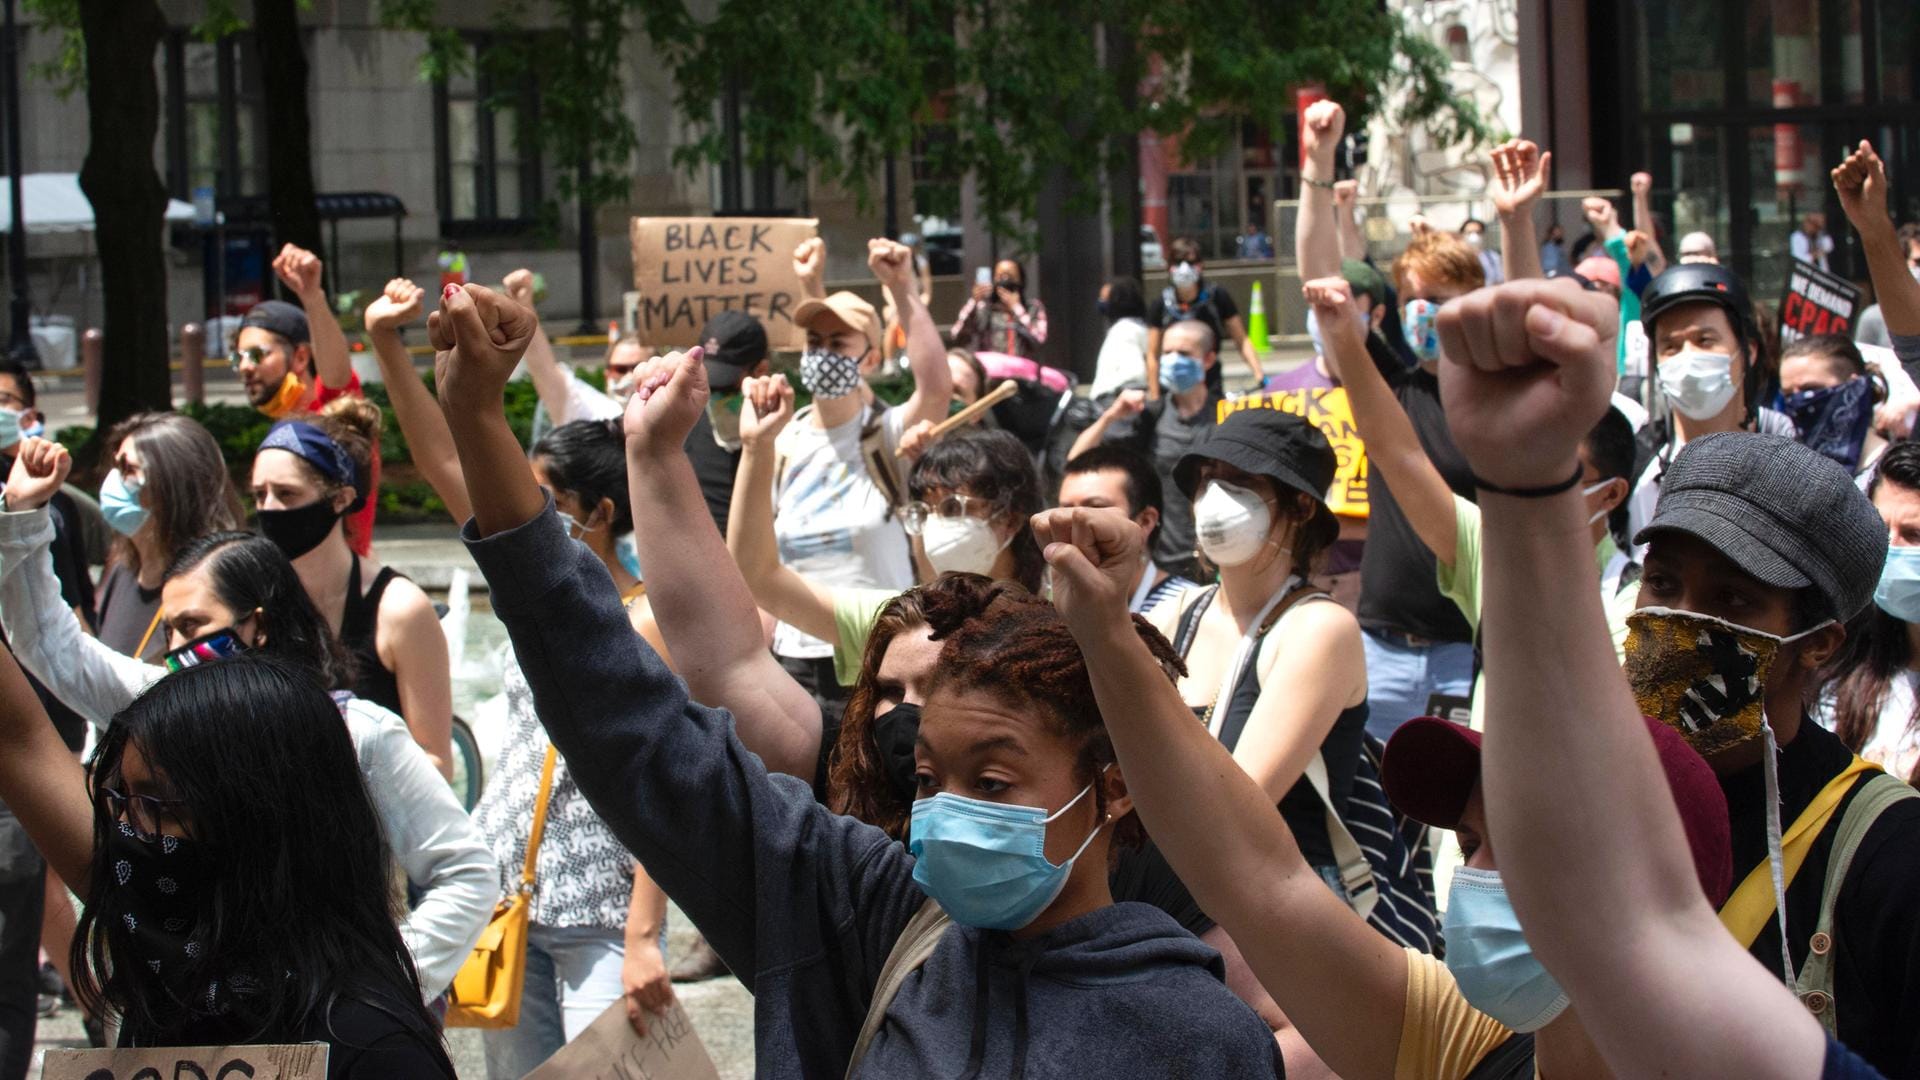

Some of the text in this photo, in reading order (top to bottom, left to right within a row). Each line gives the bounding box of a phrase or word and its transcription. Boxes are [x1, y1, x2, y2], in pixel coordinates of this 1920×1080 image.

[665, 223, 773, 252] BLACK
[662, 256, 758, 285] LIVES
[639, 291, 793, 331] MATTER
